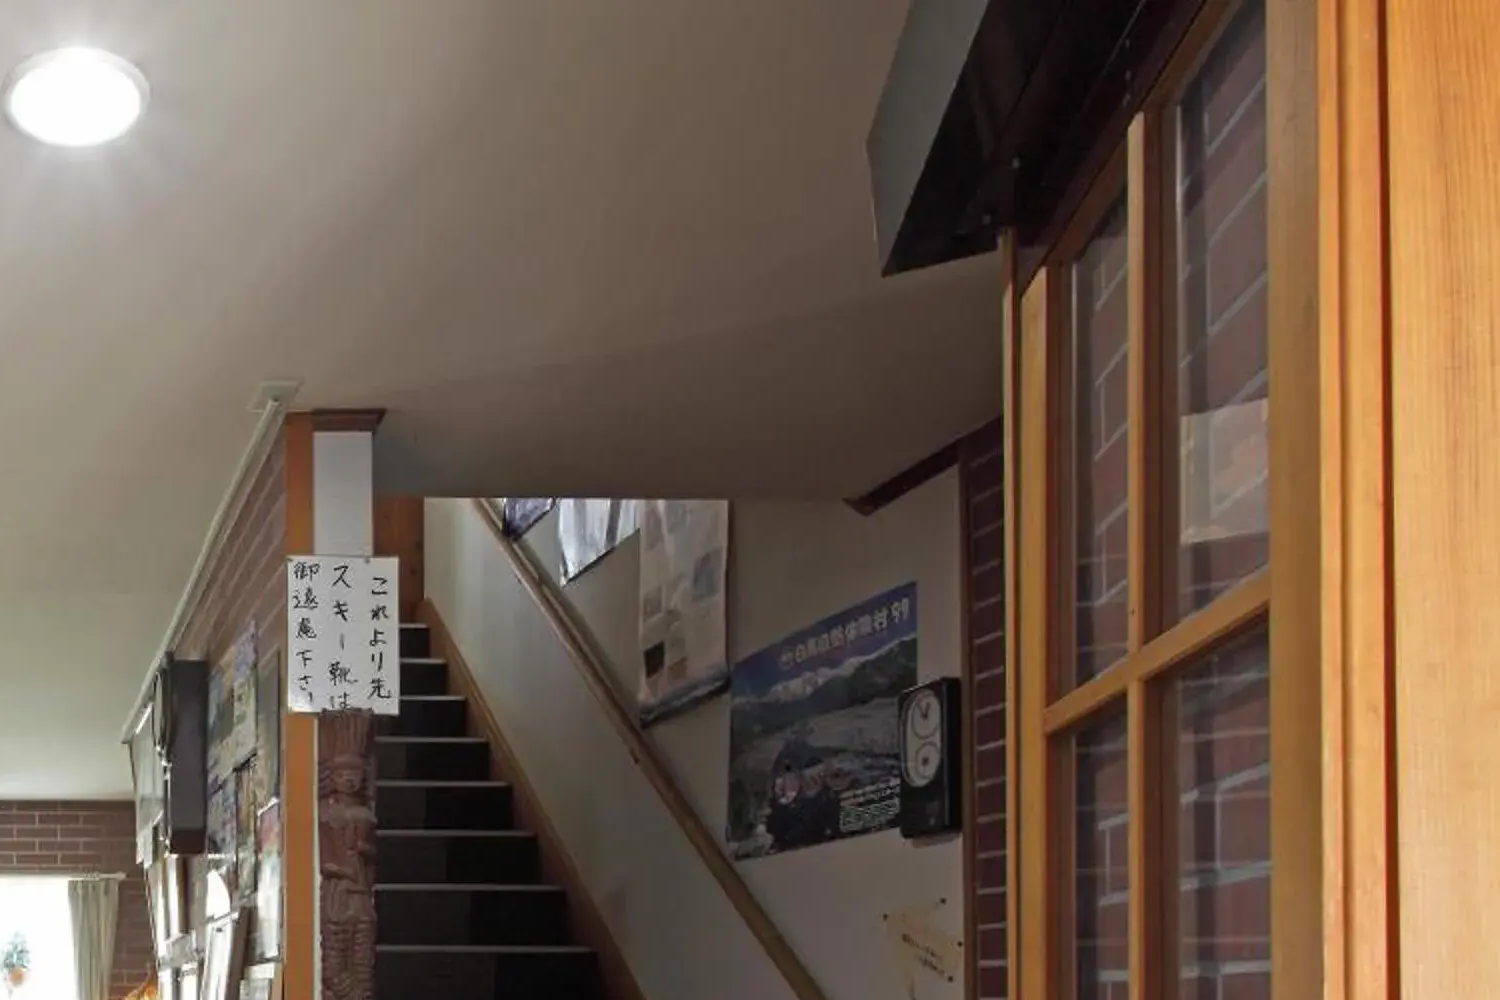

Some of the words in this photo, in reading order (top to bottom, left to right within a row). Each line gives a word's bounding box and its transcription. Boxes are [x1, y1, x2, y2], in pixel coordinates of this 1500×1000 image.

[329, 564, 359, 709] スキー靴は
[367, 576, 392, 700] これより先
